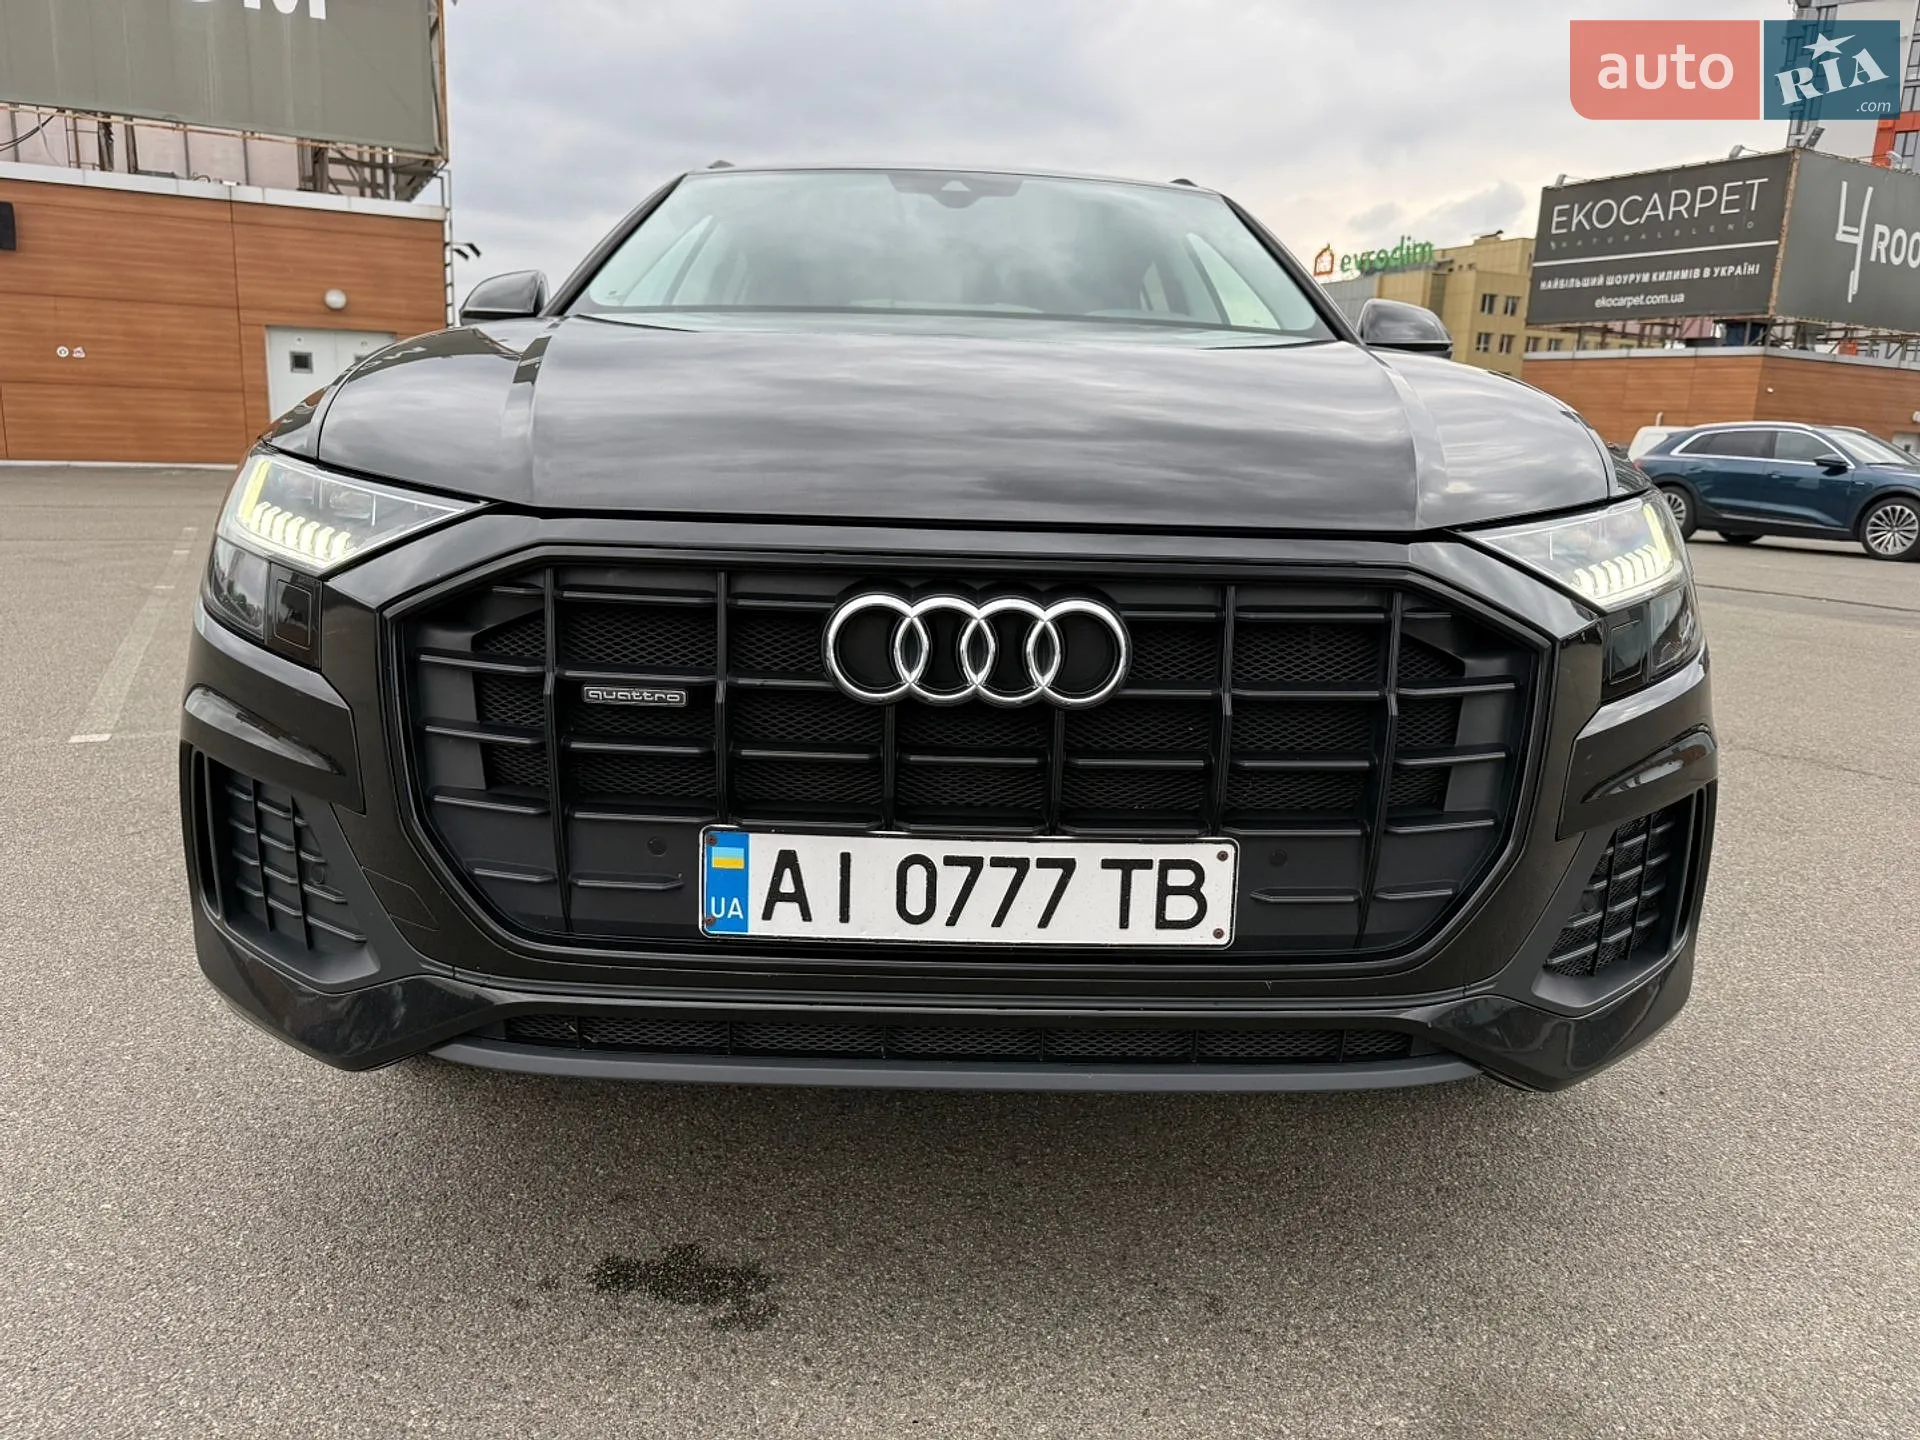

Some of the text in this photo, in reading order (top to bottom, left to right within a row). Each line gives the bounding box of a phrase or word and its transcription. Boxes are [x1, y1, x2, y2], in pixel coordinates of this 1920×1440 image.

[1551, 177, 1769, 235] EKOCARPET
[1539, 262, 1761, 290] НАЙБІЛЬШИЙ ШОУРУМ КИЛИМІВ В УКРАЇНІ
[1594, 292, 1685, 309] ekocarpet.com.ua
[588, 690, 681, 702] quattro
[761, 849, 1208, 930] AI 0777 TB
[711, 896, 744, 919] UA
